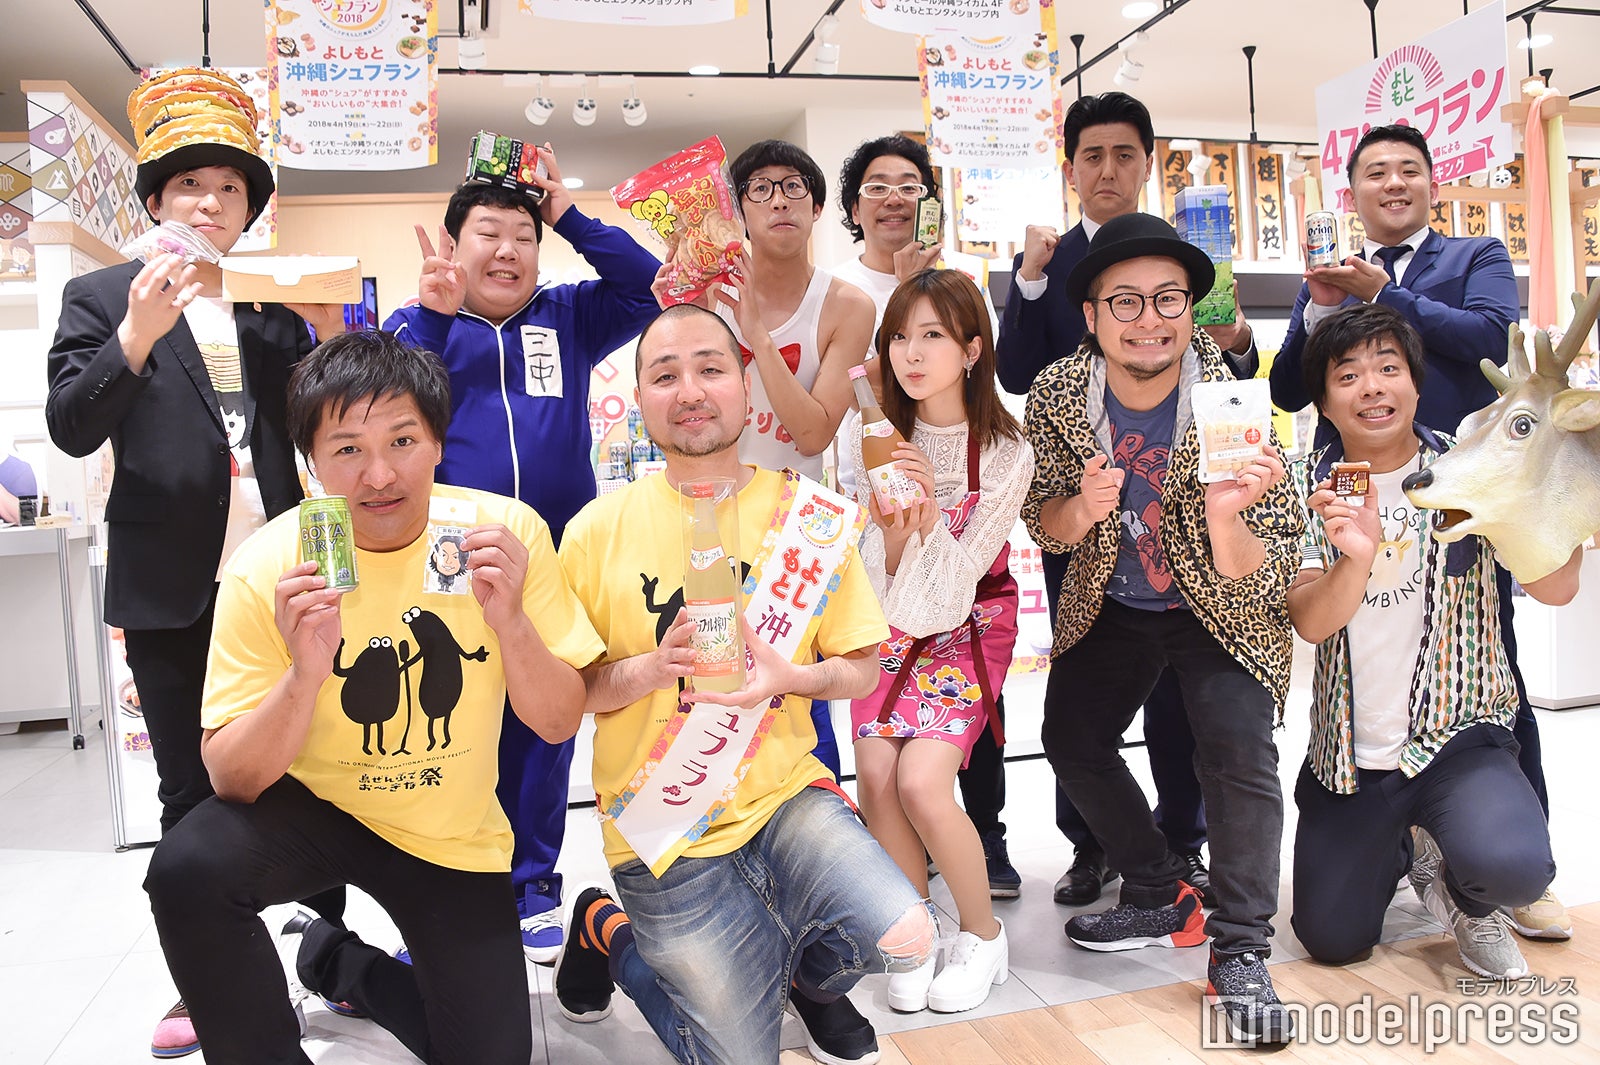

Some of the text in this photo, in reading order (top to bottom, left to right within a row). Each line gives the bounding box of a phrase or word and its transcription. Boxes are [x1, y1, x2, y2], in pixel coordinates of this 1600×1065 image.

[337, 14, 362, 23] 2018
[894, 4, 999, 19] よしもとエンタメショップ内
[323, 46, 384, 60] よしもと
[286, 62, 421, 82] 沖縄シュフラン
[963, 57, 1012, 71] よしもと
[934, 71, 1044, 90] 沖縄シュフラン
[1391, 67, 1414, 89] よし
[1391, 86, 1415, 107] もと
[1321, 66, 1505, 176] 47フラン
[958, 149, 1029, 157] よしもとエンタメショップ内
[1434, 156, 1465, 180] キング
[692, 177, 716, 208] われ
[1257, 155, 1281, 250] 桂文枝
[670, 190, 717, 267] 塩せんべい
[301, 524, 346, 541] GOYA
[307, 538, 338, 554] DRY
[771, 548, 801, 600] もと
[792, 558, 823, 609] よし
[419, 766, 443, 787] 祭
